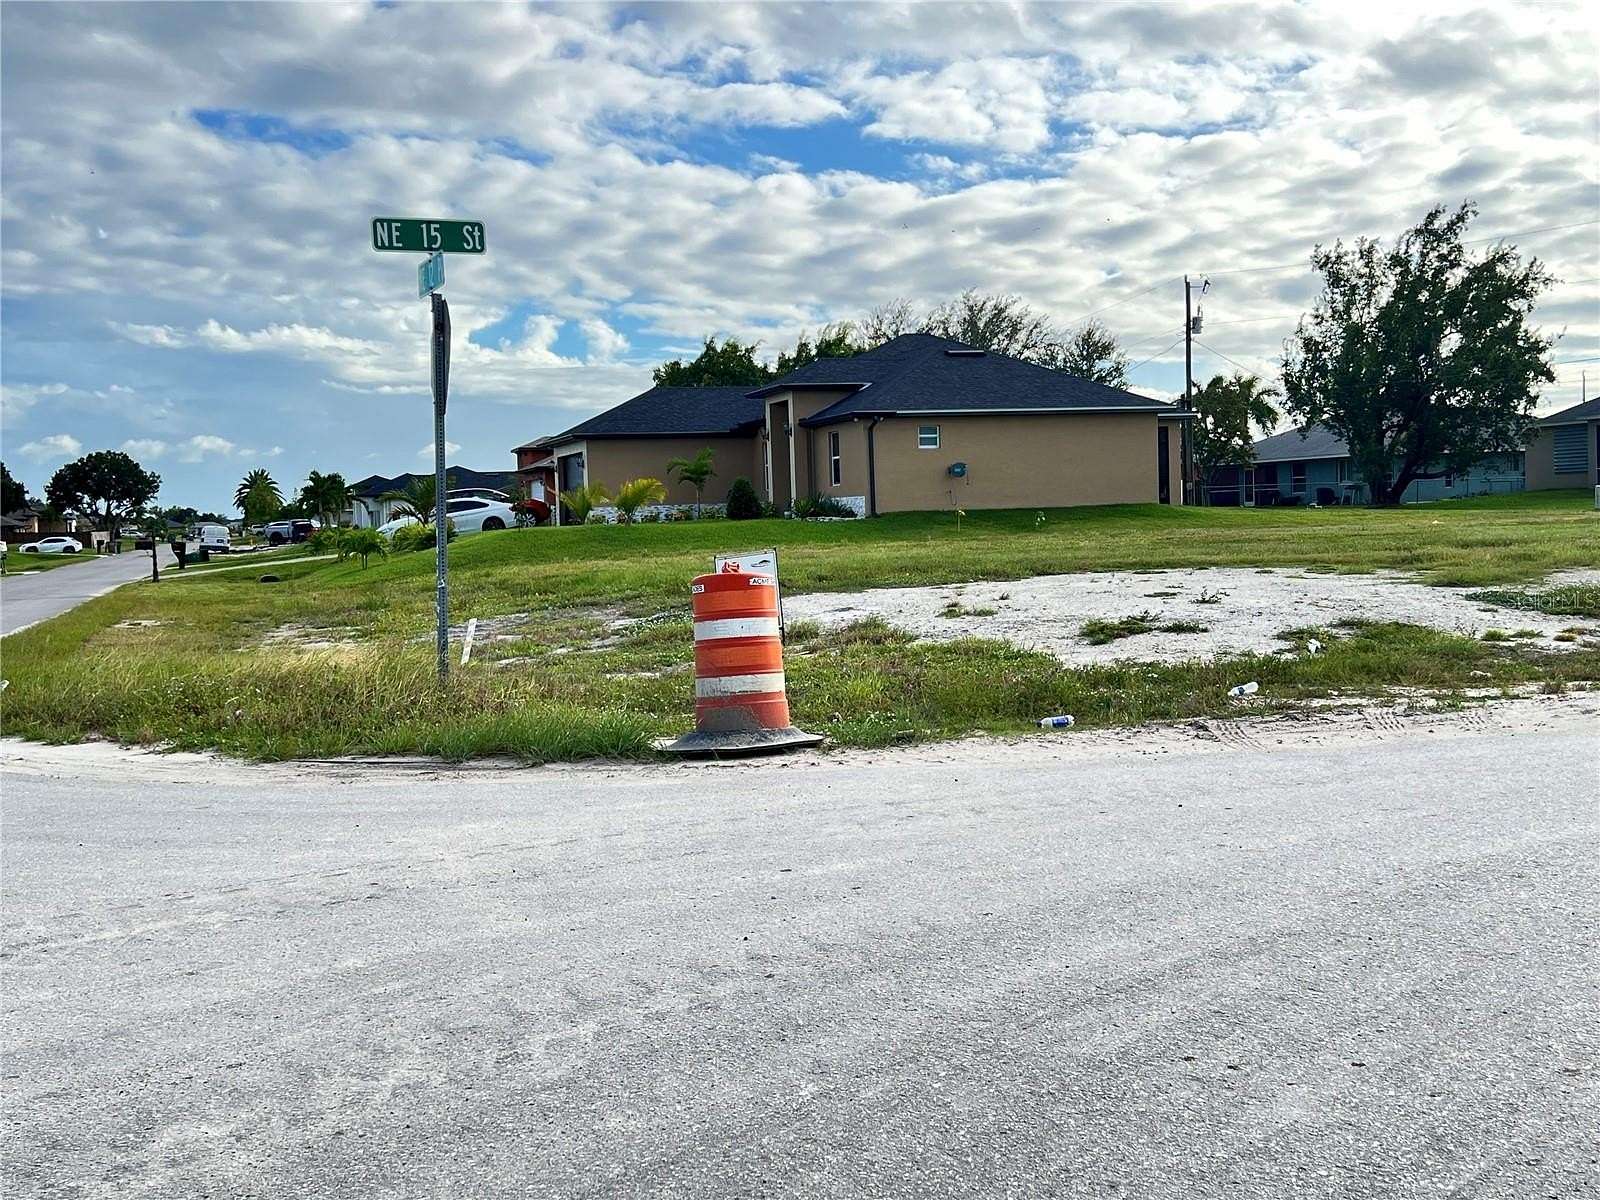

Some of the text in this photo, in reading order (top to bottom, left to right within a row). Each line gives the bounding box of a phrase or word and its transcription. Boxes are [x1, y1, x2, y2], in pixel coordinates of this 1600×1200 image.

[376, 222, 482, 250] NE 15 St
